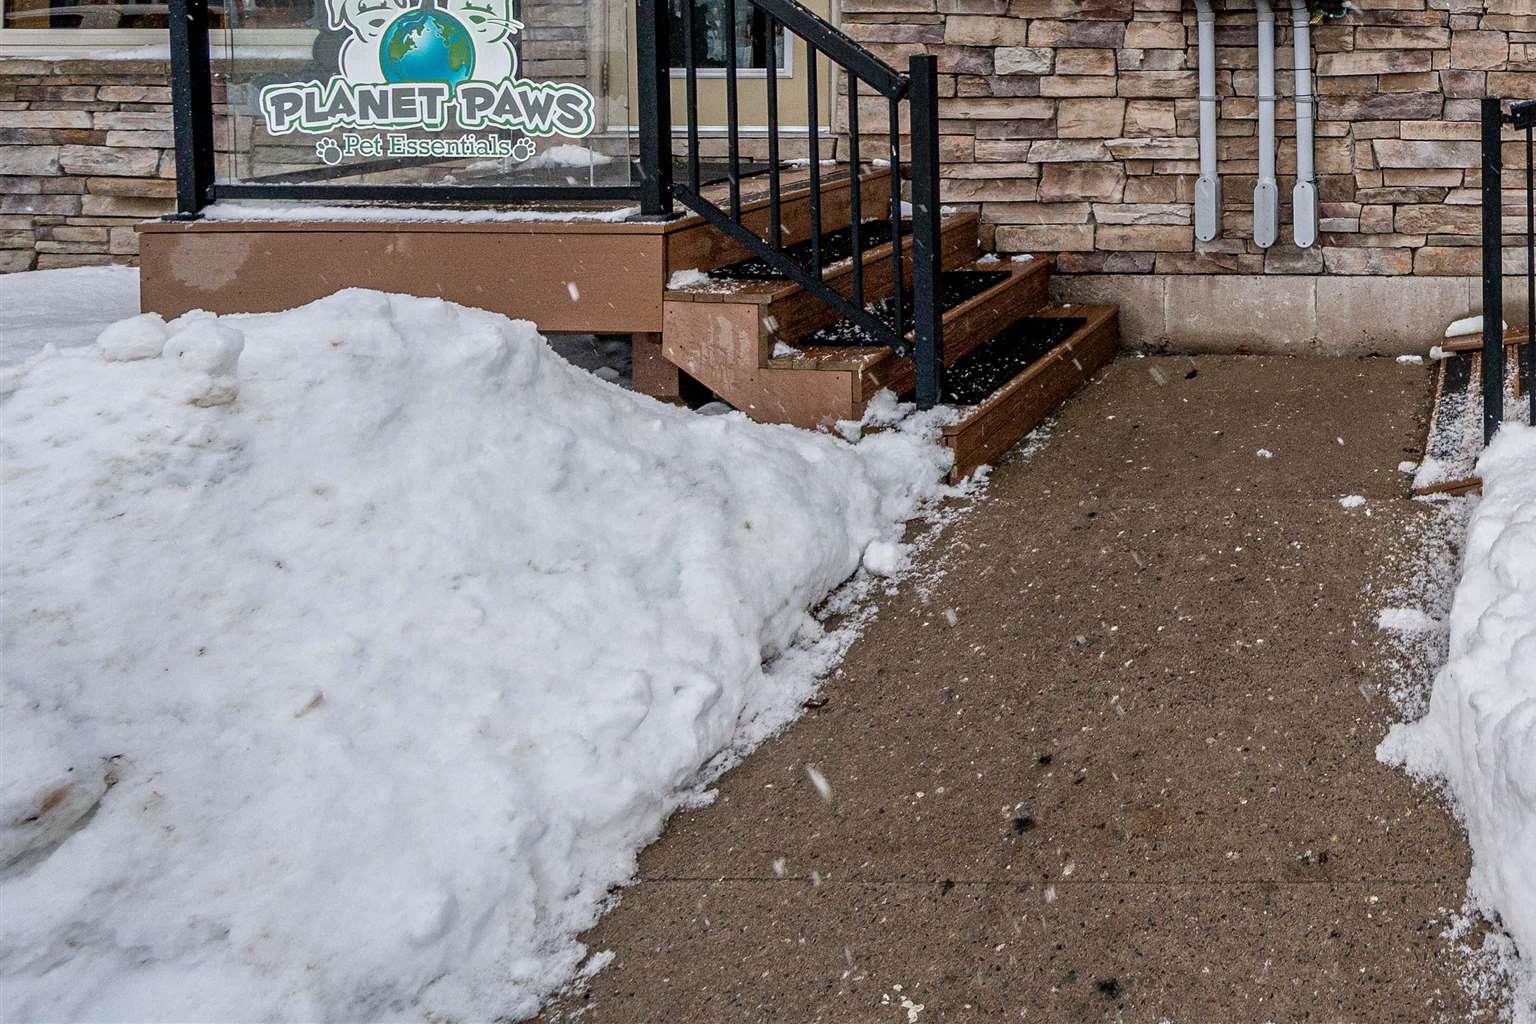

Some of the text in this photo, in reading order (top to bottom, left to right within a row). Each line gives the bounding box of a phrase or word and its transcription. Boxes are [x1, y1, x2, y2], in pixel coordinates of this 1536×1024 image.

[269, 80, 586, 129] PLANET PAWS
[342, 135, 512, 158] Pet Essentials
